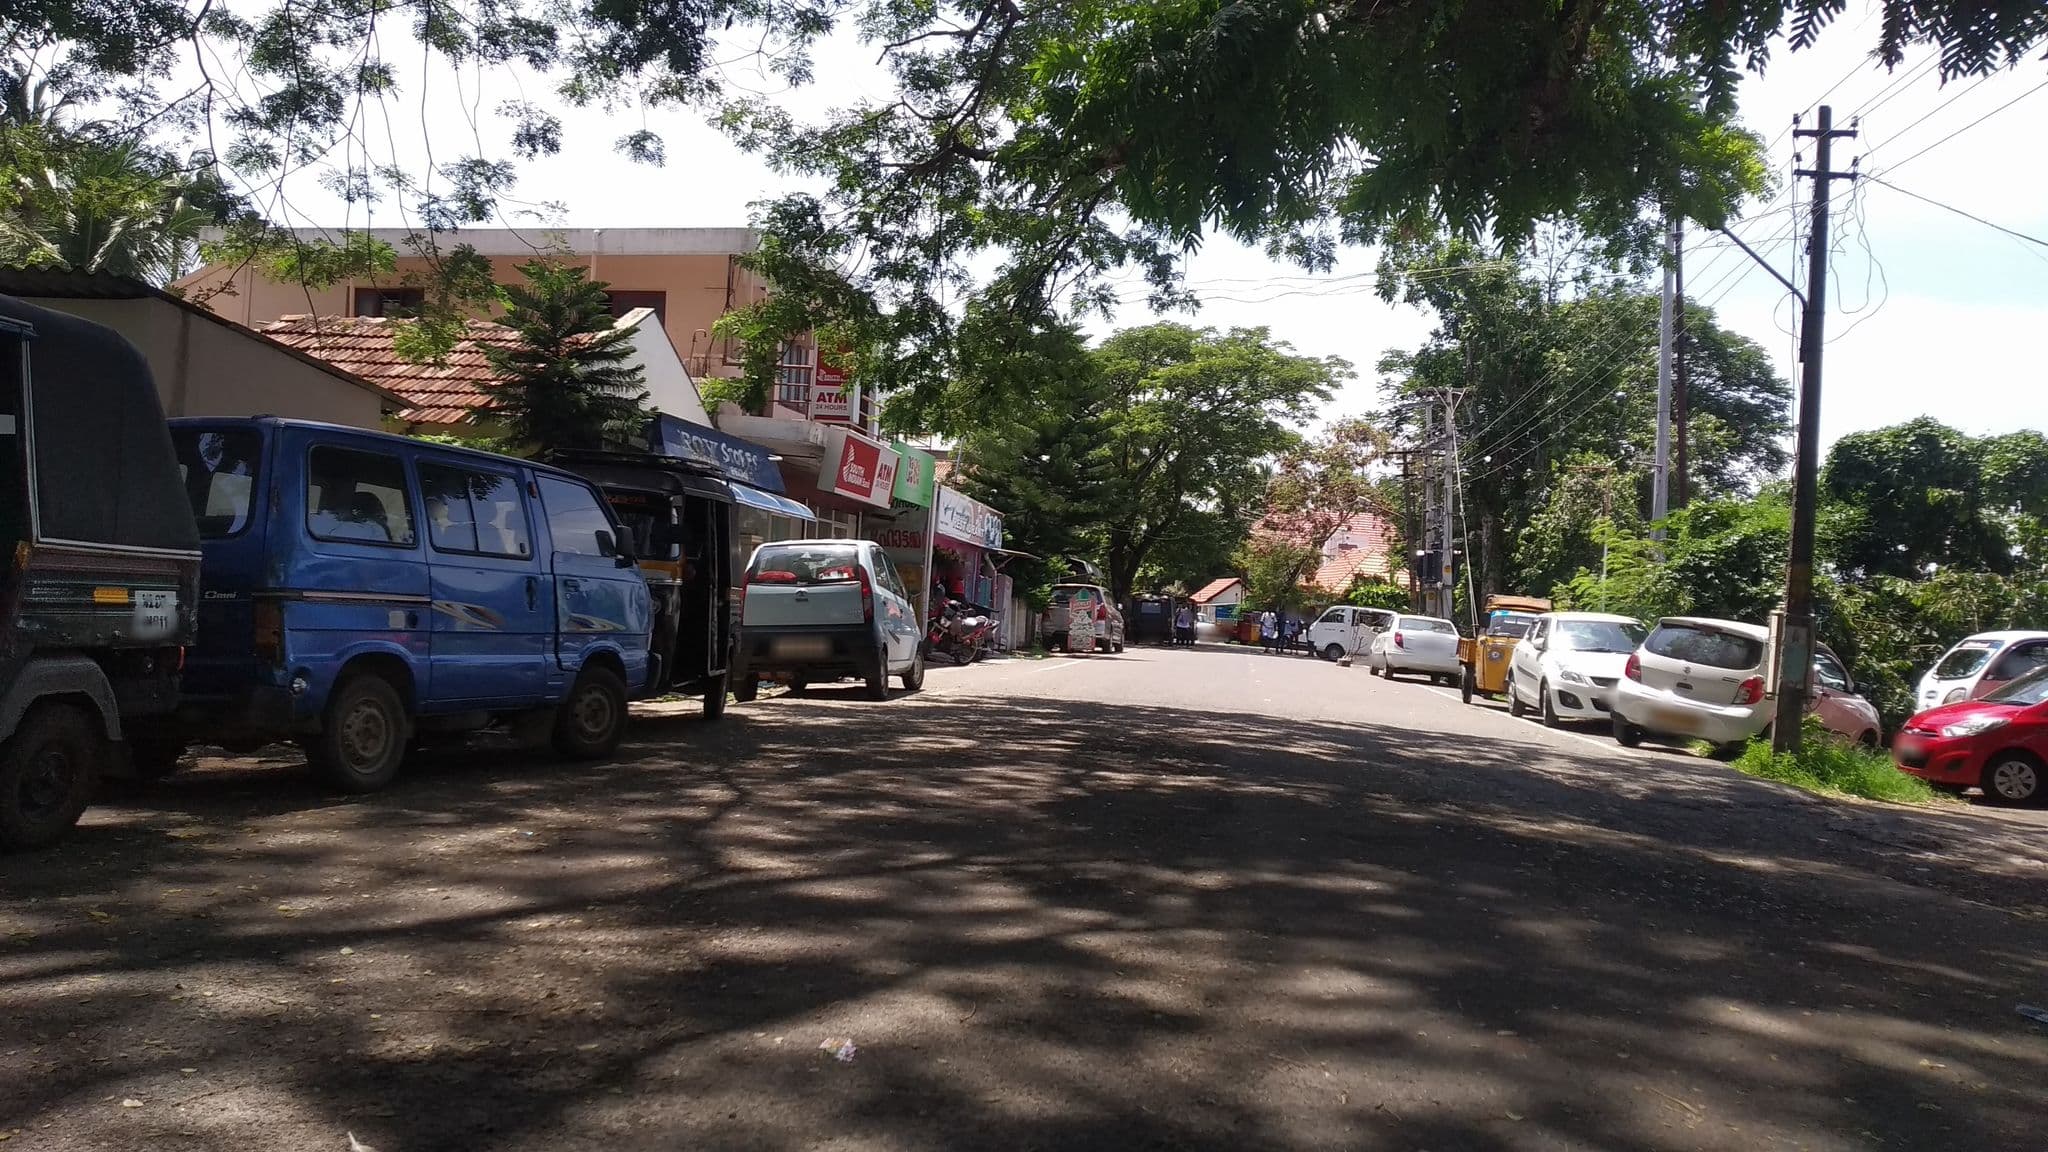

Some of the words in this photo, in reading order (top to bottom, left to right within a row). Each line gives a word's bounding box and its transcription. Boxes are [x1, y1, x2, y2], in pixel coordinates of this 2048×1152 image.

[816, 392, 847, 404] ATM
[878, 463, 892, 482] ATM
[204, 590, 238, 600] Omni
